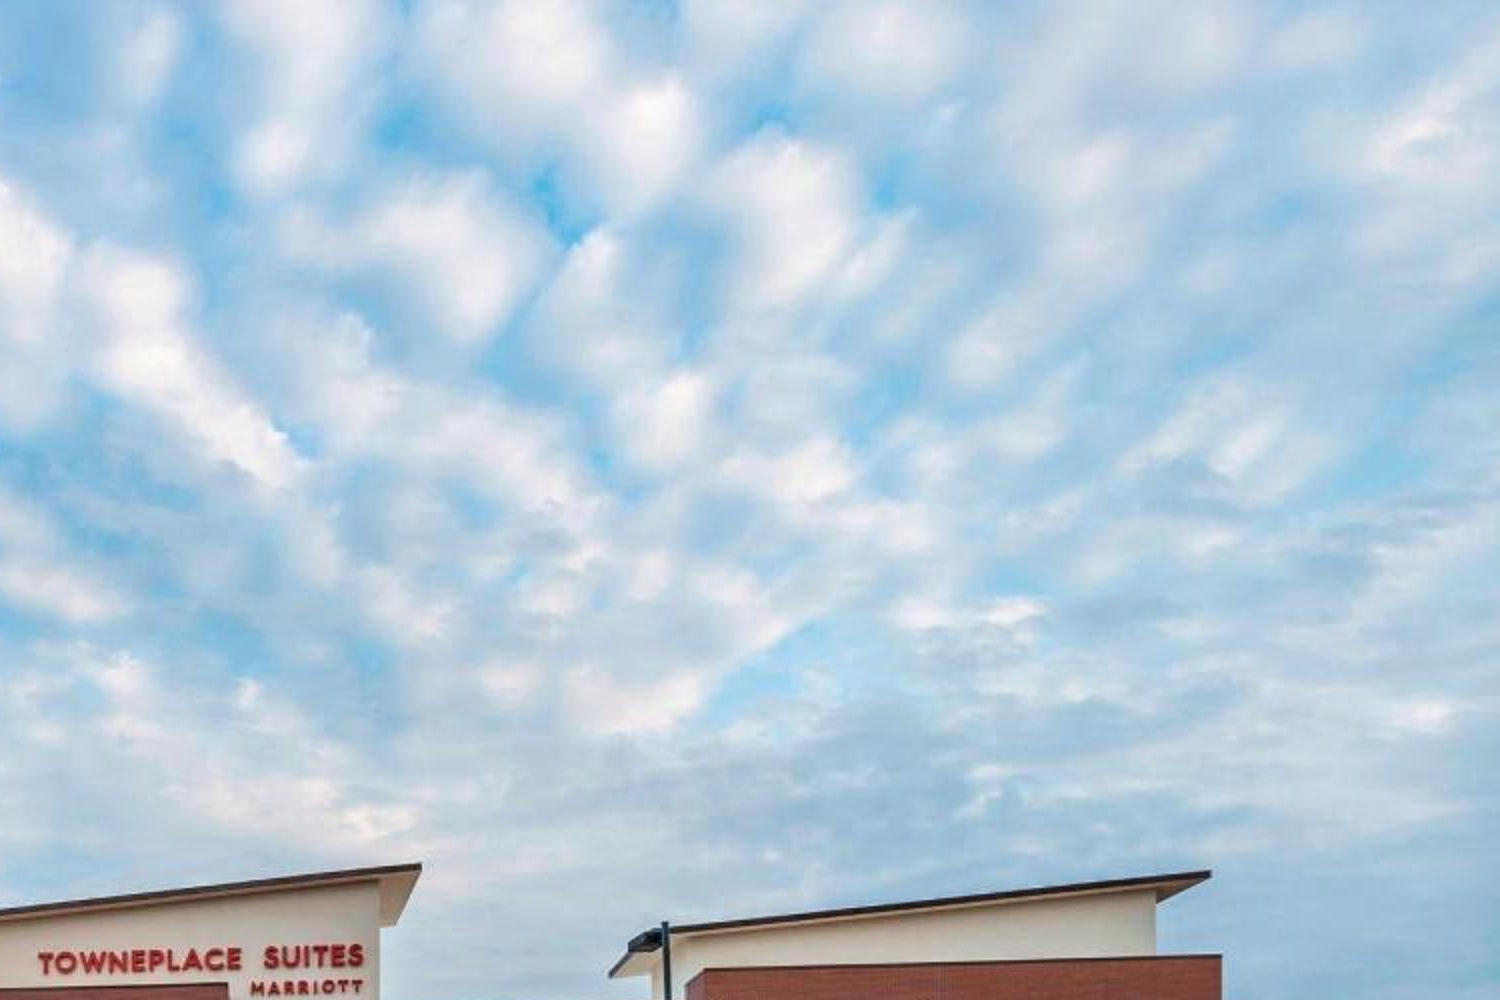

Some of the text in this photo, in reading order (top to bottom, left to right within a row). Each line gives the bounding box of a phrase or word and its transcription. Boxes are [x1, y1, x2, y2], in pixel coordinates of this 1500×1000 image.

[38, 944, 364, 974] TOWNEPLACE SUITES
[250, 980, 364, 996] MARRIOTT
